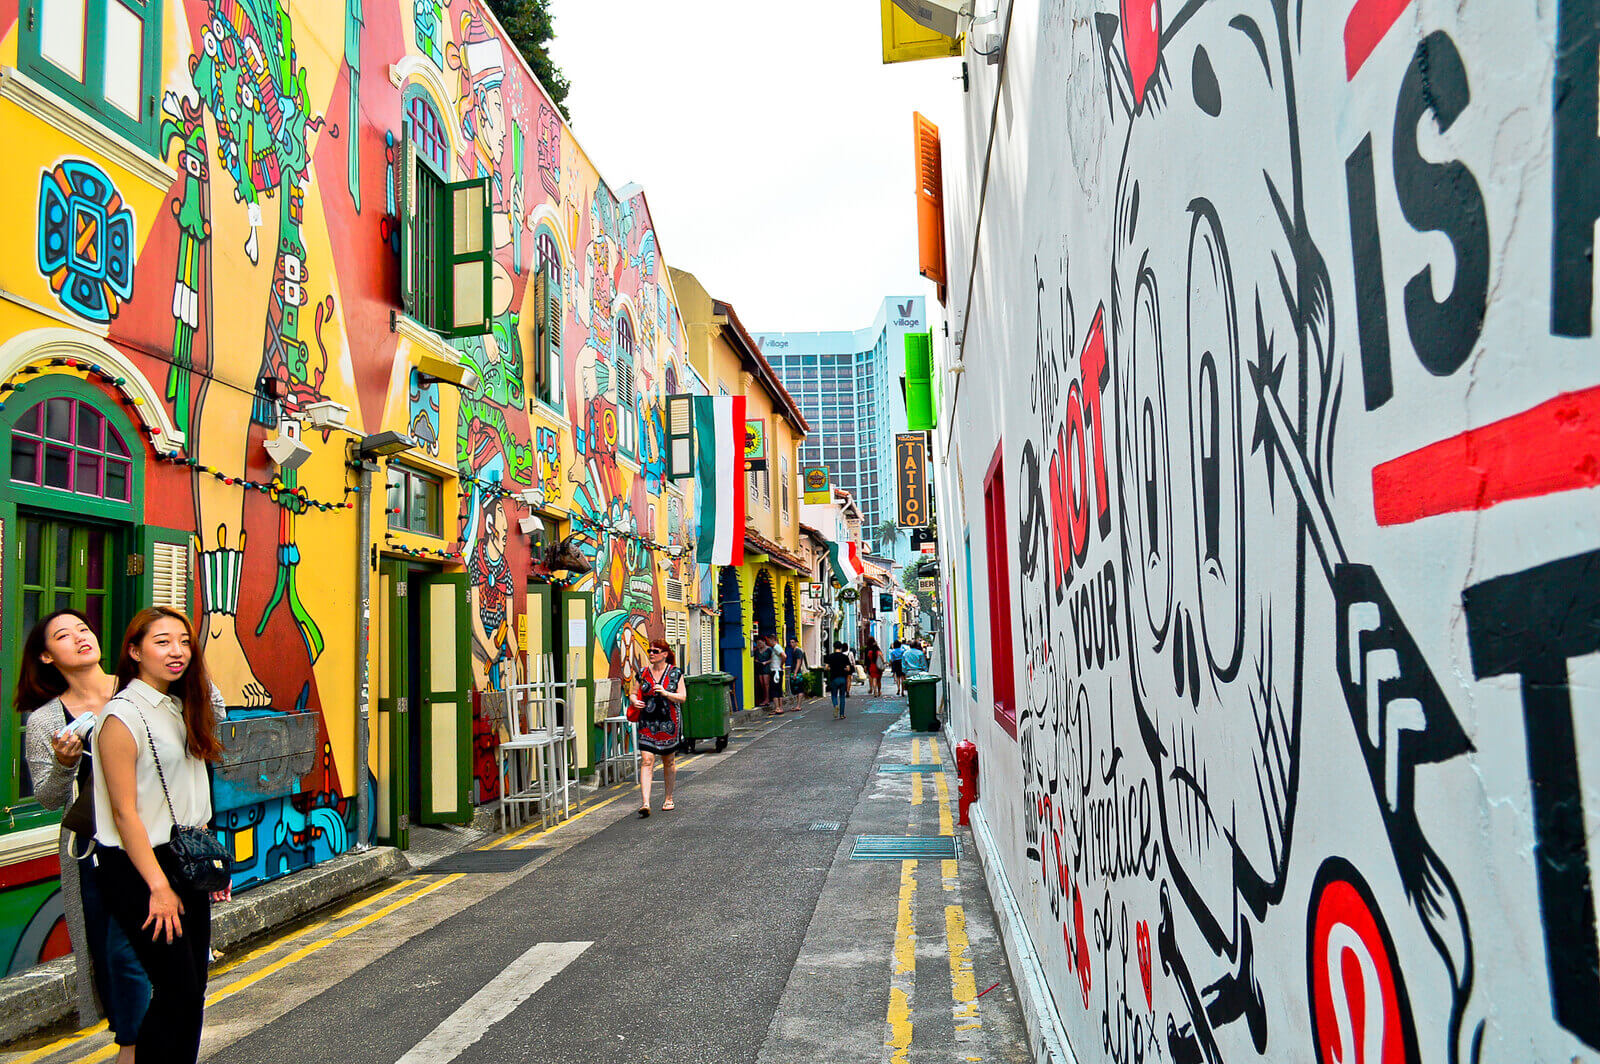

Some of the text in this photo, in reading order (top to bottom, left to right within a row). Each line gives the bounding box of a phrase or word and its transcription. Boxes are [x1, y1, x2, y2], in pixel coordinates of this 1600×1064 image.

[1344, 29, 1491, 412] IS
[765, 340, 789, 349] village
[893, 318, 919, 328] village
[905, 442, 919, 526] TATTOO
[1048, 298, 1111, 607] NOT
[1069, 559, 1120, 677] YOUR
[1069, 676, 1161, 888] Practice
